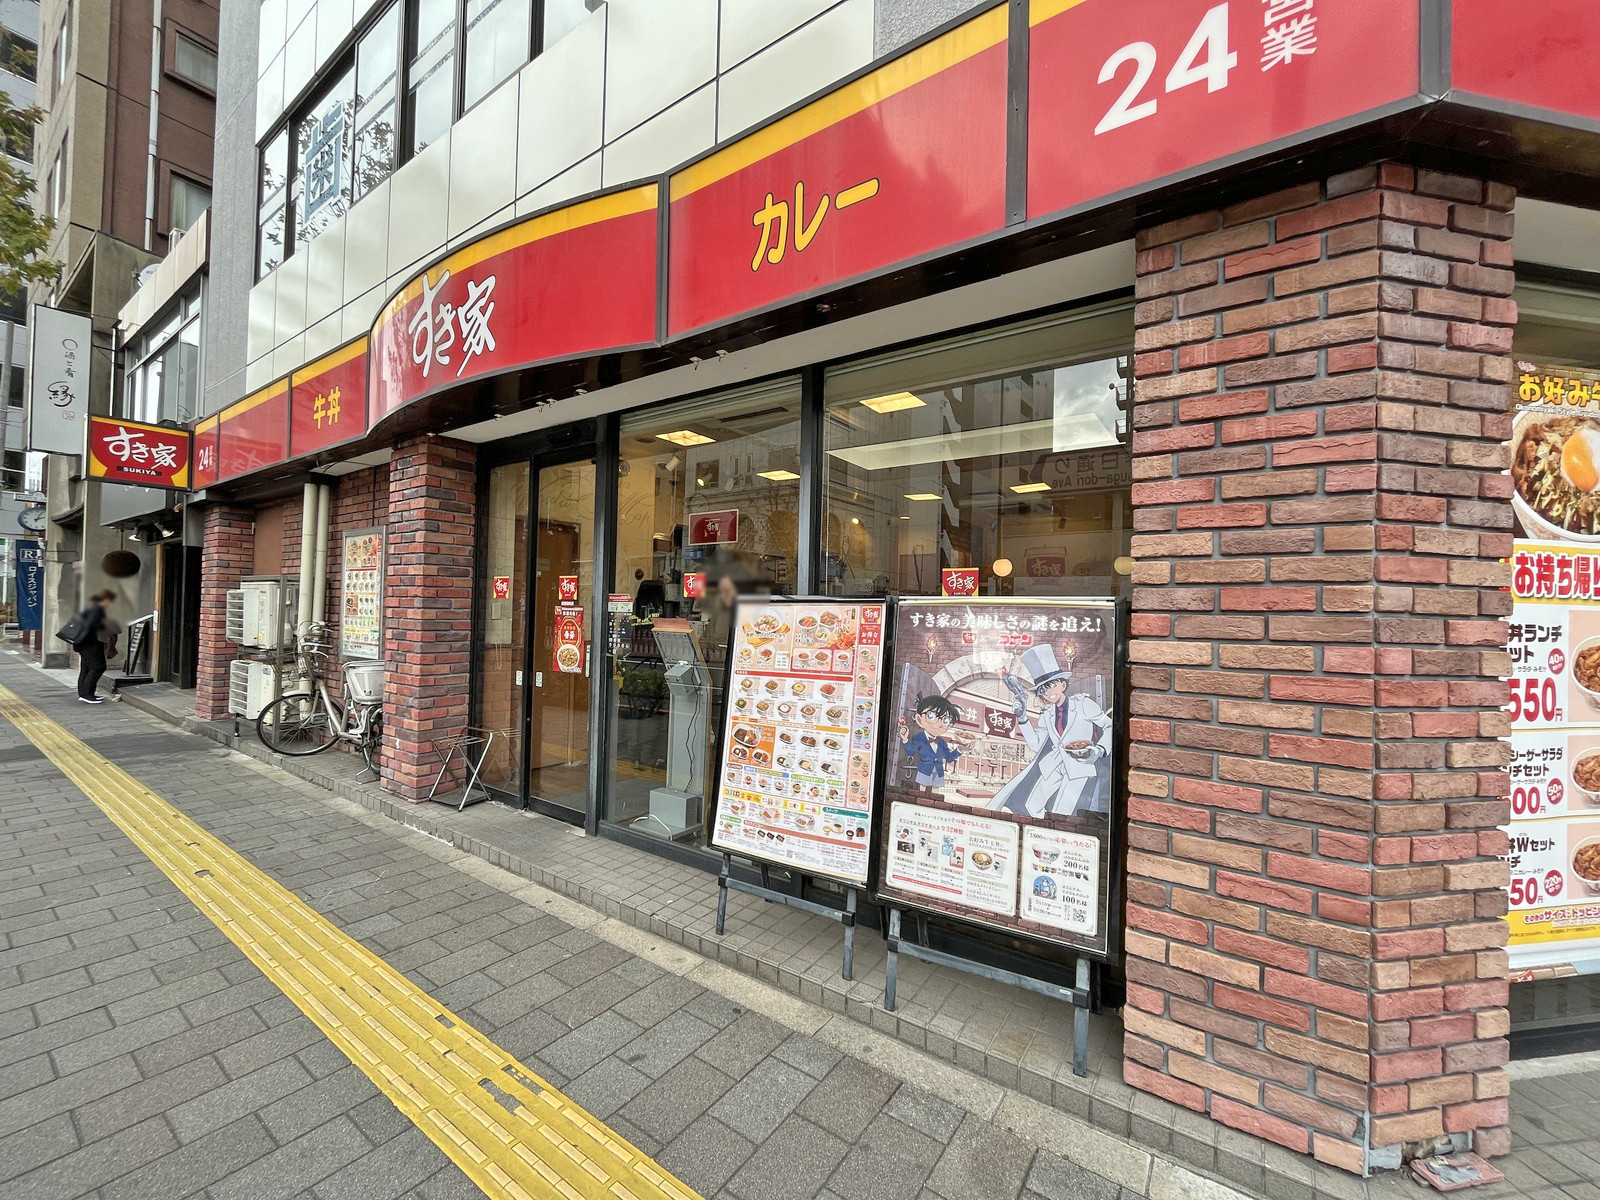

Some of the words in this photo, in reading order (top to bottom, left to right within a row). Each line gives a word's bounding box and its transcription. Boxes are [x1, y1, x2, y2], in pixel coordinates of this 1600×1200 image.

[1095, 3, 1238, 136] 24
[751, 178, 880, 272] カレー
[408, 269, 496, 378] すき家
[313, 386, 341, 430] 牛丼
[102, 426, 177, 469] すき家
[198, 446, 209, 471] 24
[123, 467, 157, 476] SUKIYA
[946, 571, 975, 592] すき家
[1503, 645, 1534, 663] ット
[988, 709, 1012, 730] すき家
[1506, 787, 1546, 815] 00円
